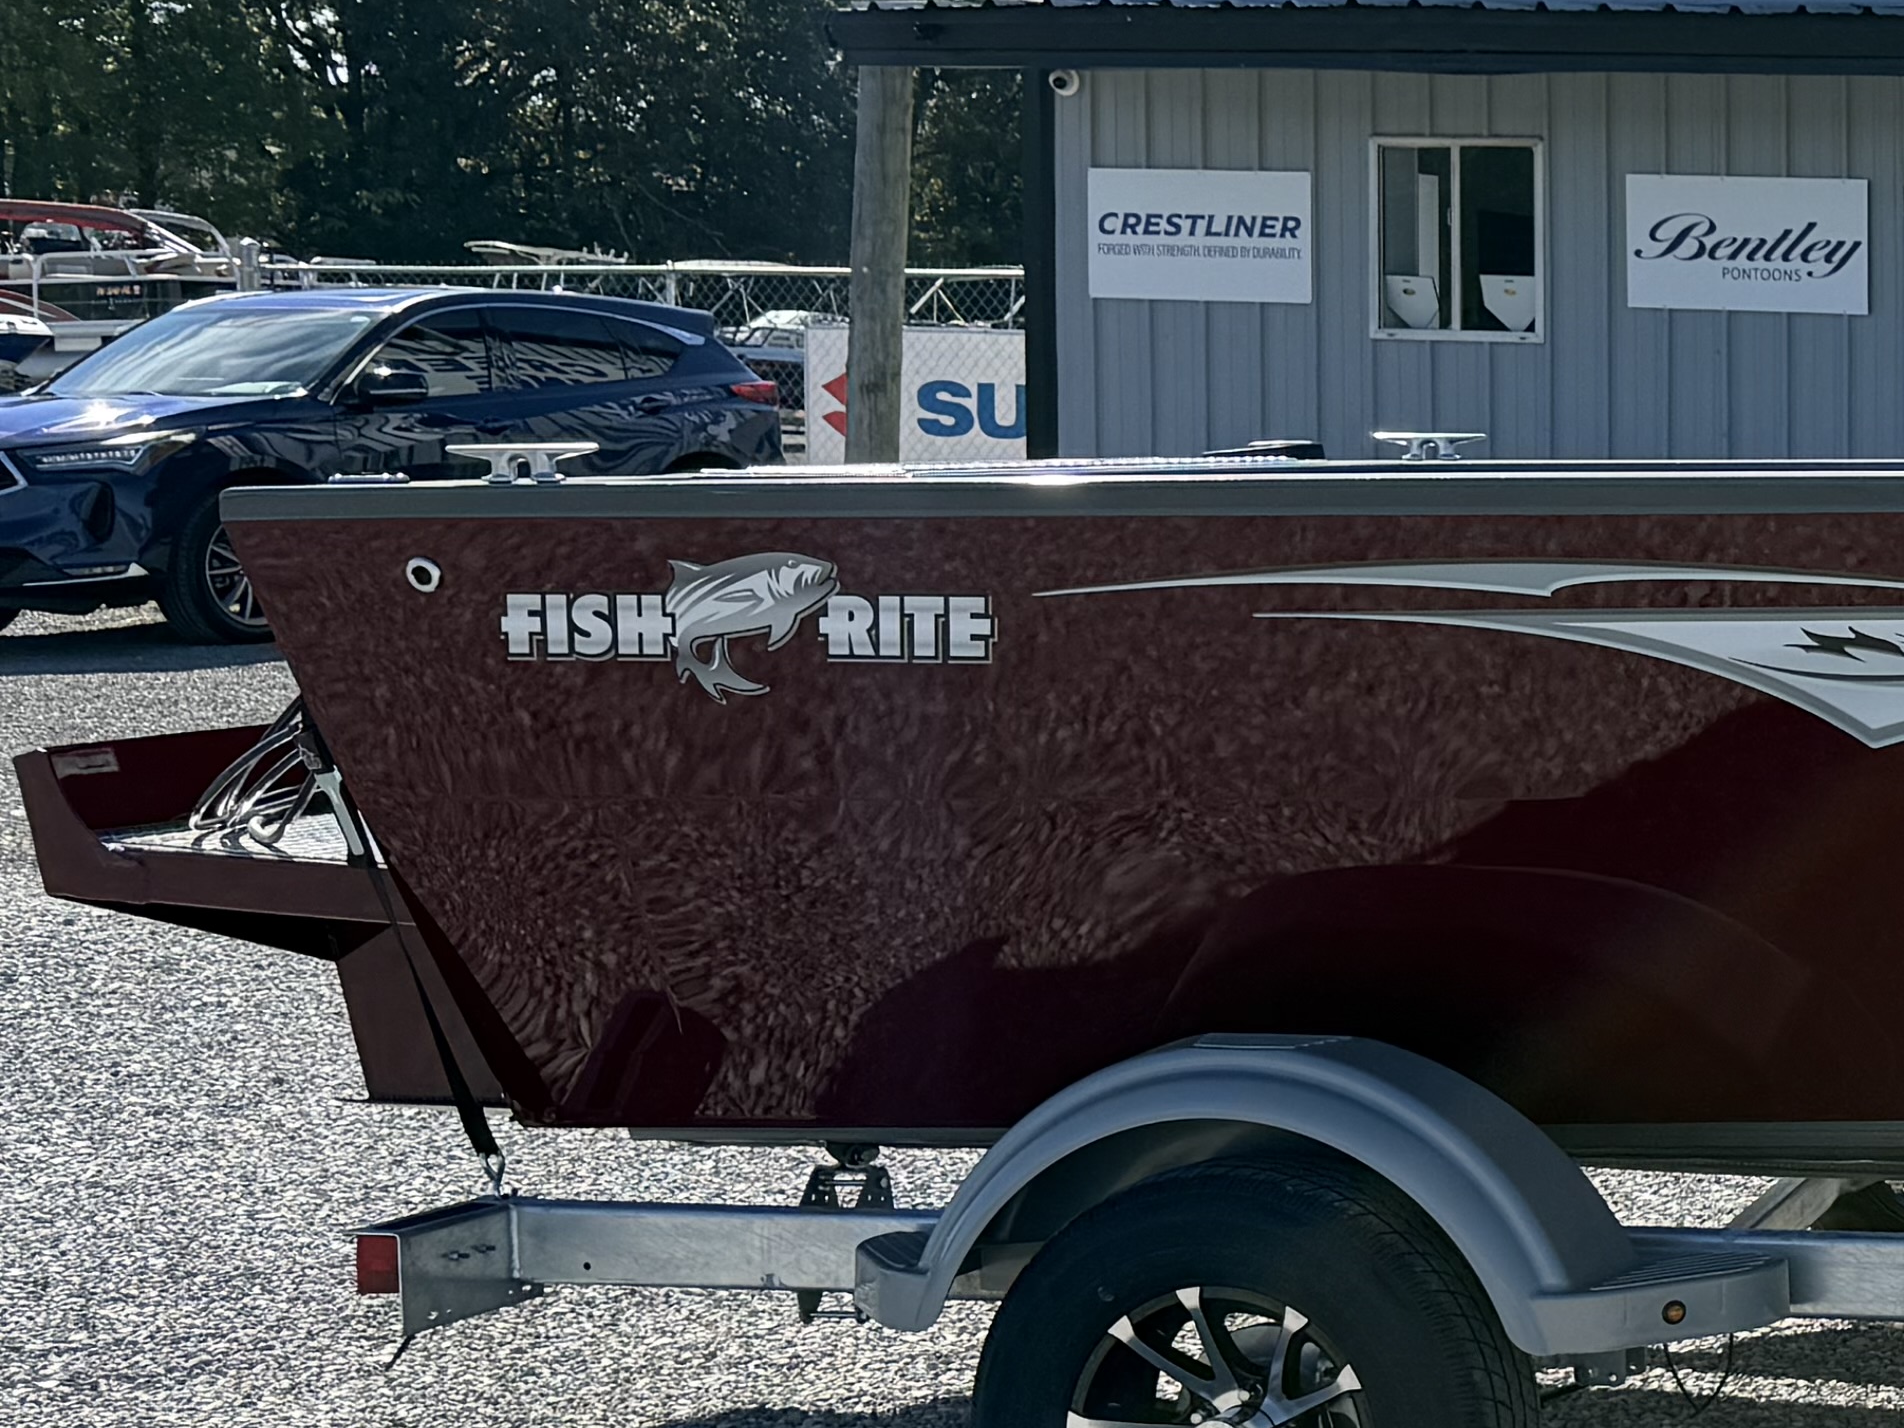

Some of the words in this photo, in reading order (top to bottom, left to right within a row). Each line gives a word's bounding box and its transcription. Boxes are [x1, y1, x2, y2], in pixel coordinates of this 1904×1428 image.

[1098, 212, 1302, 239] CRESTLINER
[1097, 243, 1131, 256] FORGED
[1240, 246, 1251, 259] BY
[1633, 212, 1862, 279] Bentley
[1722, 267, 1802, 282] PONTOONS
[501, 592, 677, 661] FISH
[819, 593, 998, 663] RITE
